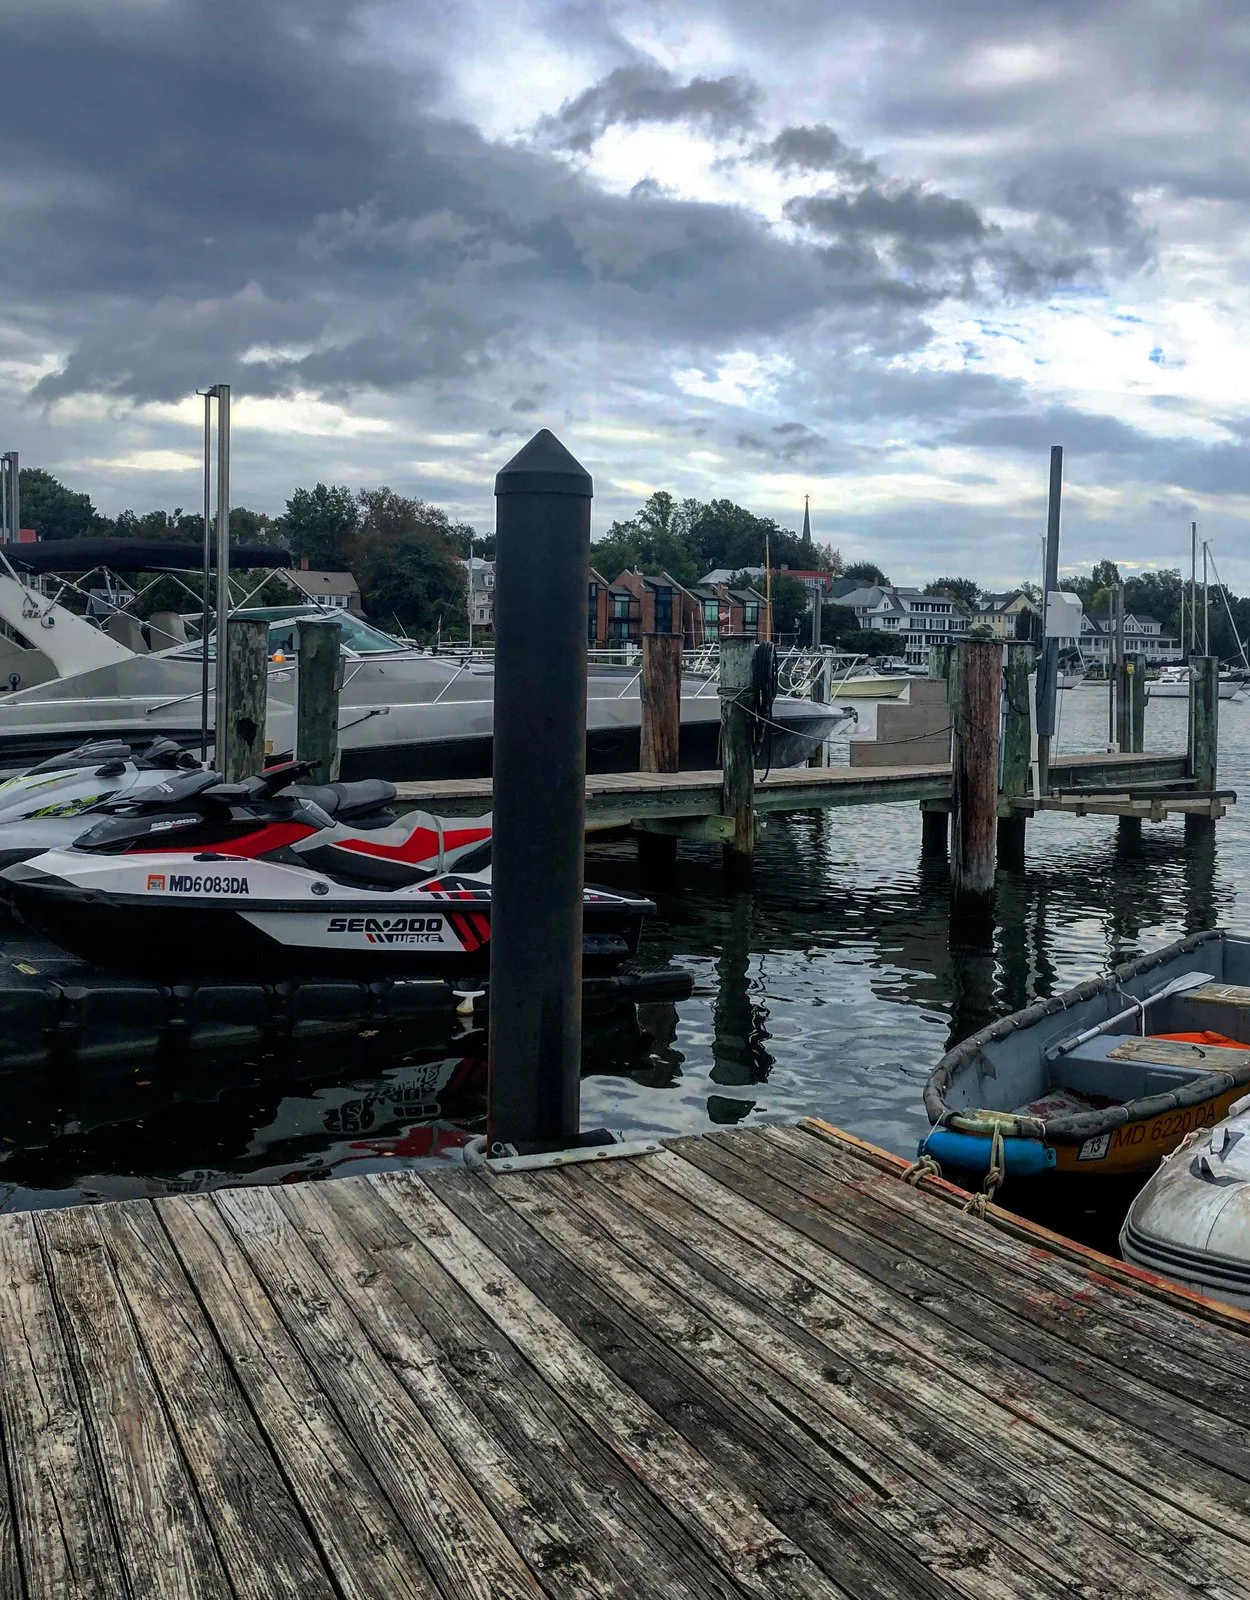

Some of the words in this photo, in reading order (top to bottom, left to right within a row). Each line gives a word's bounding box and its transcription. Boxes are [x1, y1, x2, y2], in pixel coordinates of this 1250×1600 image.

[169, 874, 249, 894] MD6083DA
[391, 934, 444, 943] WAKE
[1113, 1125, 1146, 1149] MD
[1151, 1112, 1192, 1140] 6220
[1194, 1103, 1216, 1127] DA
